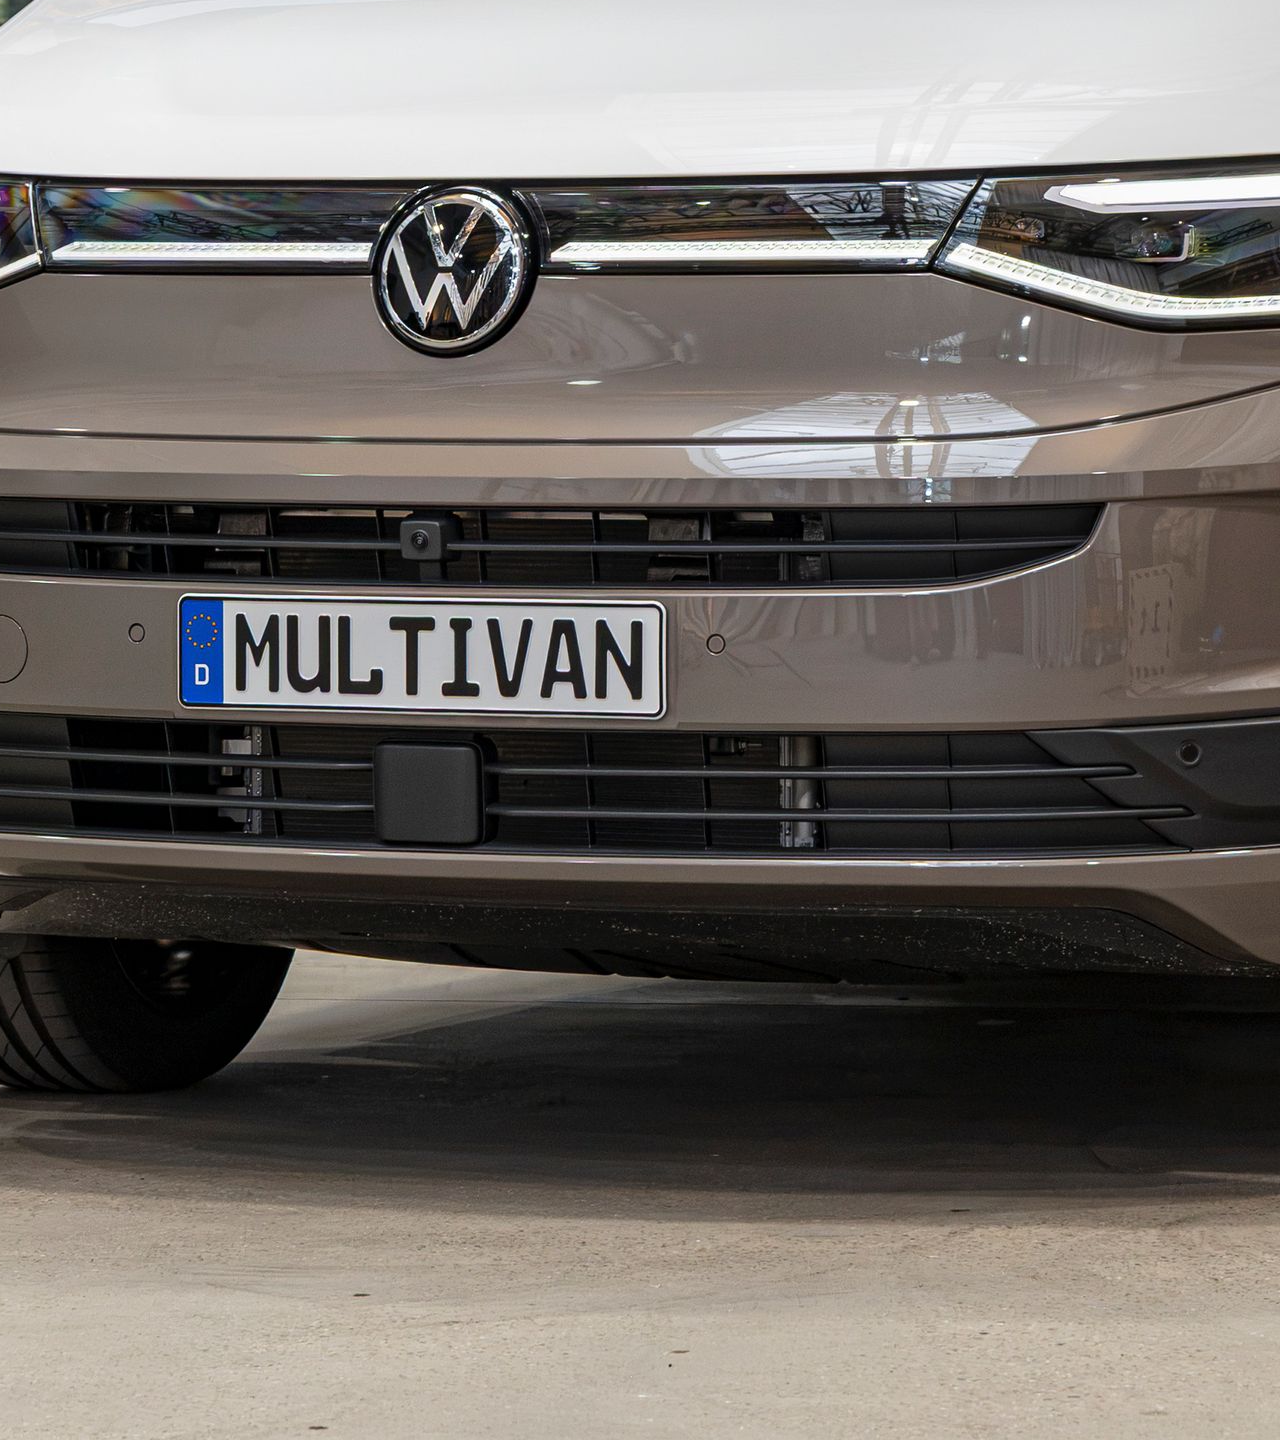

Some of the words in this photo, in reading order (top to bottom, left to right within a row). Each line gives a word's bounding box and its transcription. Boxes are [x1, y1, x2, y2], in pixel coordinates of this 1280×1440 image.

[384, 193, 520, 343] VW
[195, 663, 210, 686] D
[235, 612, 643, 701] MULTIVAN
